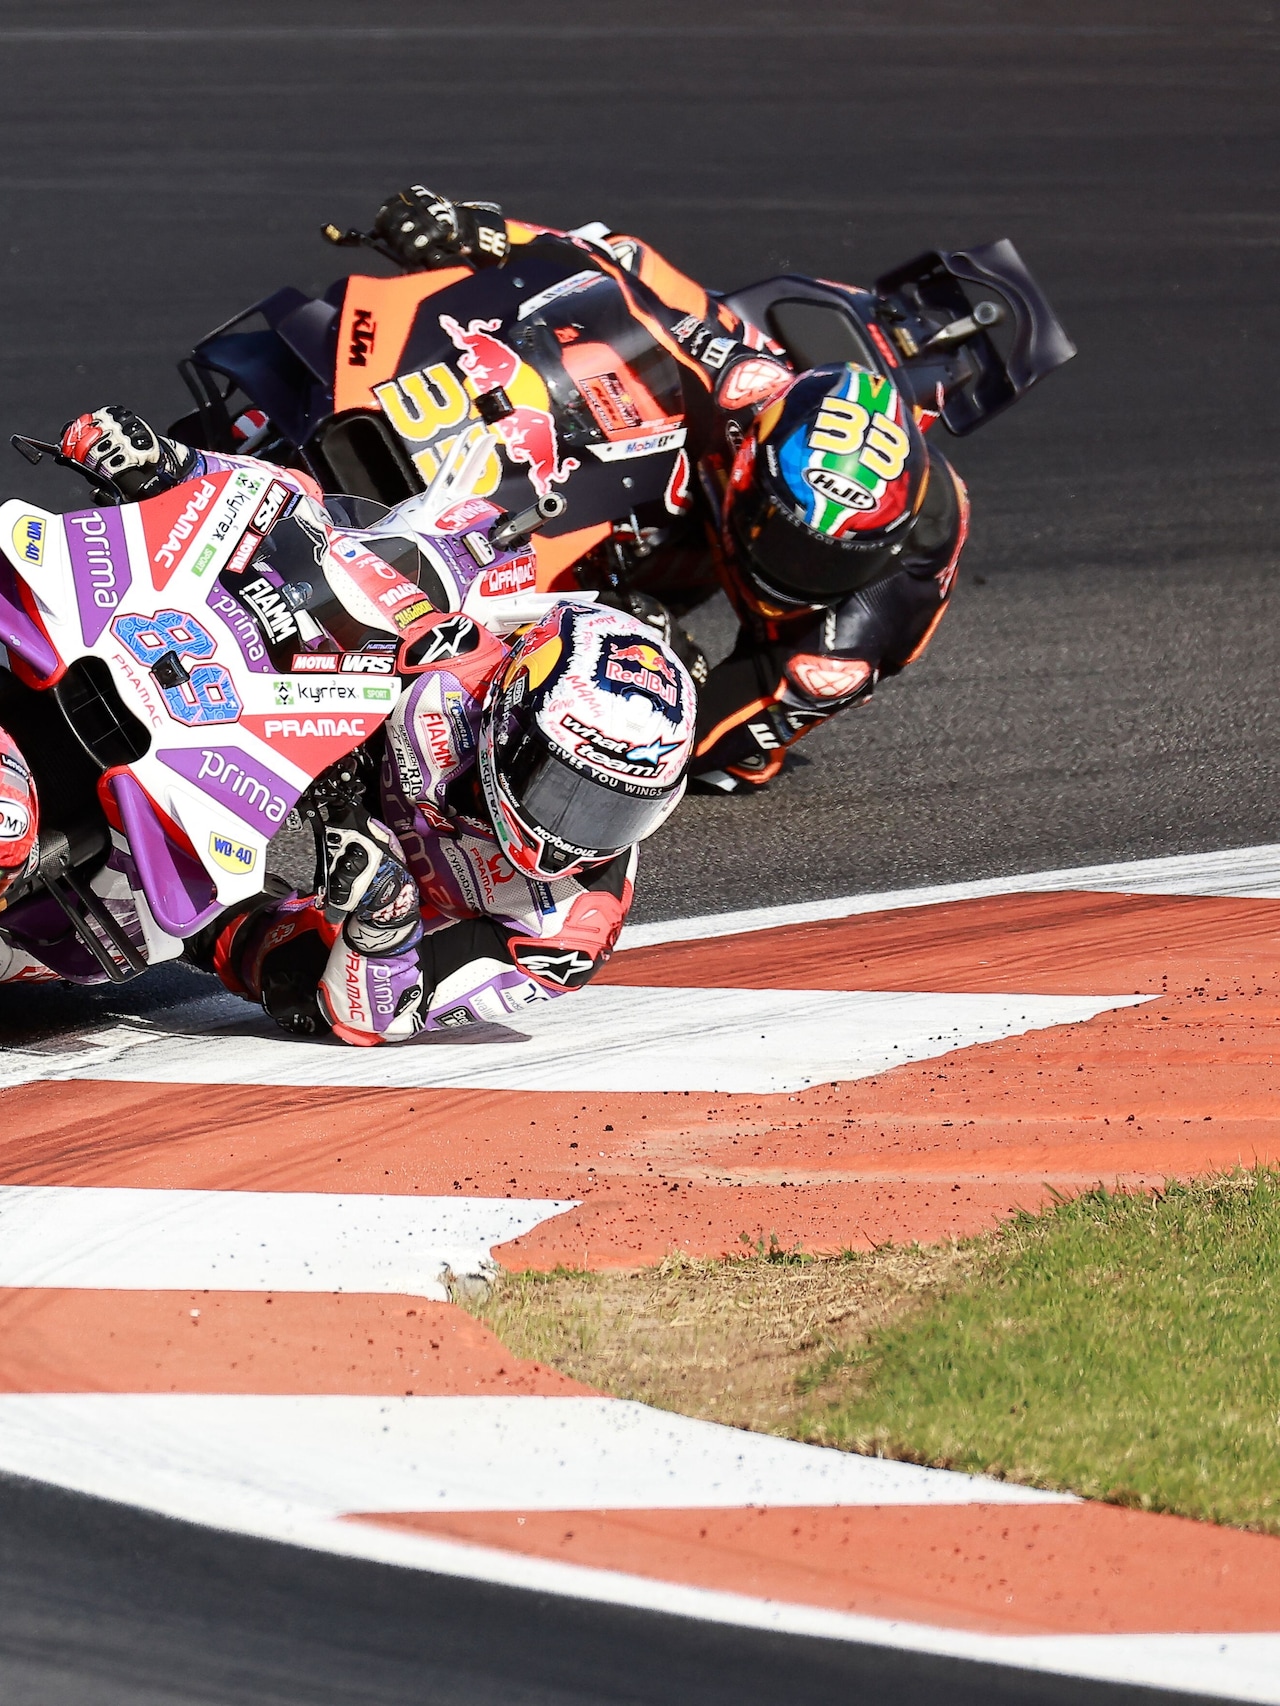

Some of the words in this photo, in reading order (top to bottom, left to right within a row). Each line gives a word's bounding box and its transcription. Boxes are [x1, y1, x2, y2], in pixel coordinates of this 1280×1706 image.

[349, 309, 375, 367] KTM
[808, 396, 910, 481] 33
[212, 490, 252, 542] kyrrex
[254, 481, 290, 534] WRS
[814, 474, 870, 506] HJC
[154, 478, 217, 570] PRAMAC
[71, 510, 118, 608] prima
[227, 534, 260, 571] MOTUL
[212, 595, 264, 661] prima
[242, 577, 298, 643] FIAMM
[110, 608, 244, 727] 89
[293, 656, 337, 671] MOTUL
[341, 655, 395, 673] WRS
[111, 654, 163, 728] PRAMAC
[297, 682, 357, 703] kyrrex
[264, 719, 366, 738] PRAMAC
[422, 713, 457, 770] FIAMM
[561, 715, 629, 755] what
[197, 750, 287, 823] prima
[395, 748, 412, 797] HELMET
[548, 742, 584, 771] GIVES
[590, 768, 619, 788] YOU
[624, 783, 663, 797] WINGS
[577, 744, 665, 778] team!
[214, 836, 253, 865] WD-40
[533, 825, 598, 858] MOTOBLOUZ
[470, 847, 495, 906] PRAMAC
[345, 951, 366, 1023] PRAMAC
